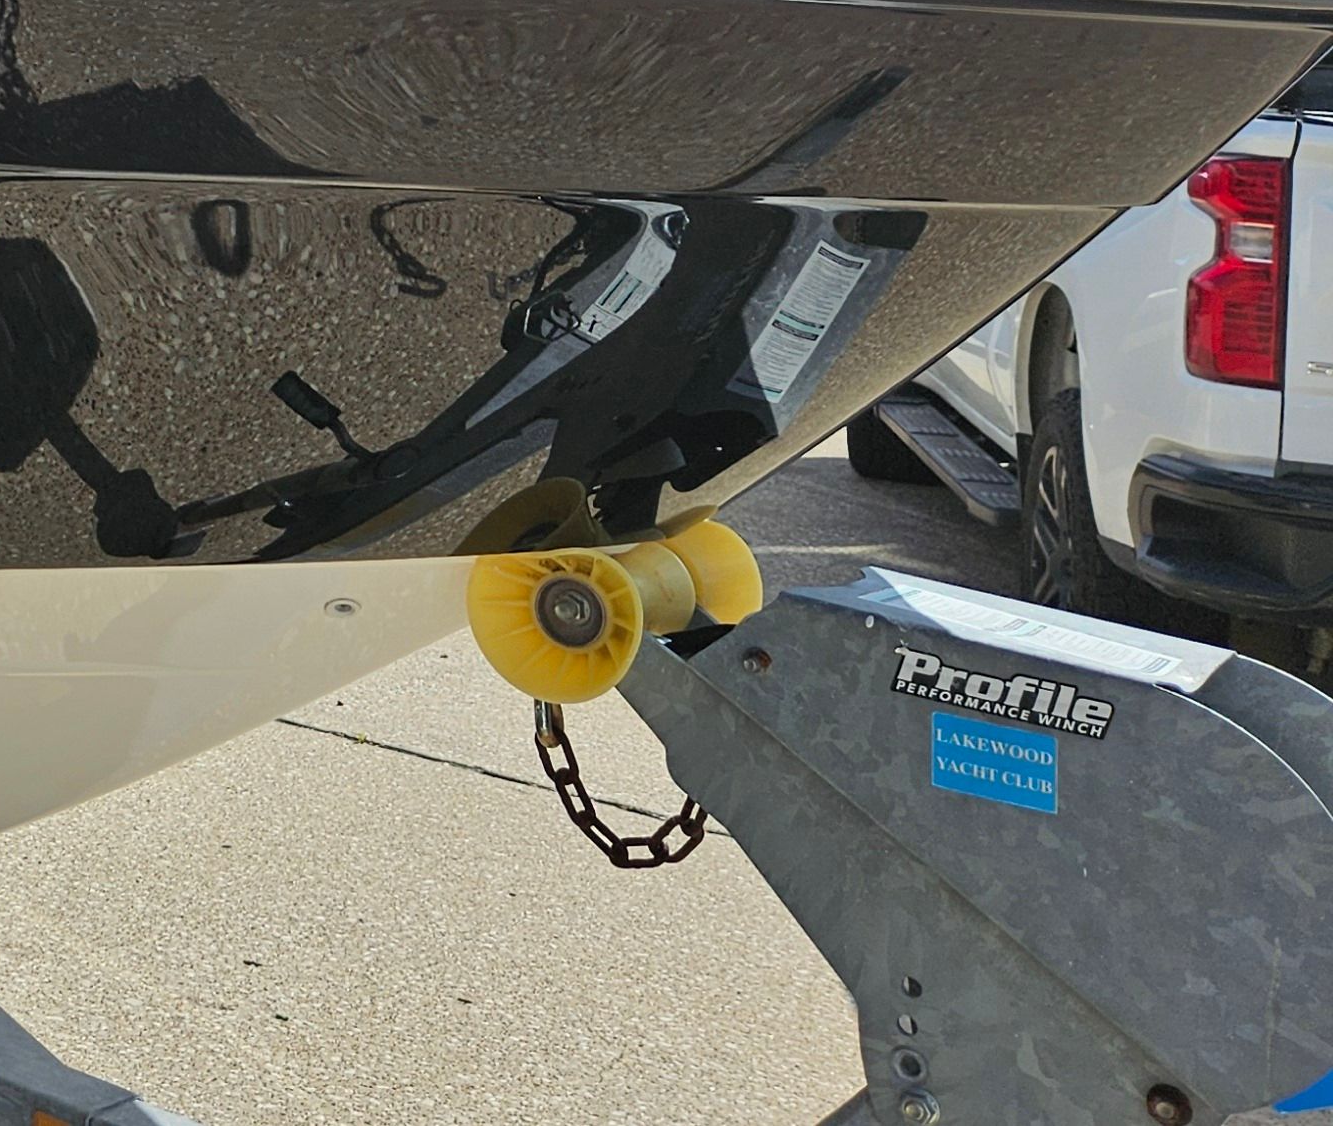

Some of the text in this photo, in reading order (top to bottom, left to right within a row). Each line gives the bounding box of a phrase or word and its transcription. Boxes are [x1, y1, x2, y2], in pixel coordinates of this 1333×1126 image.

[895, 680, 1105, 738] PERFORMANCE WINCH
[896, 649, 1113, 727] Profile
[935, 728, 1054, 766] LAKEWOOD
[935, 756, 1053, 795] YACHT CLUB
